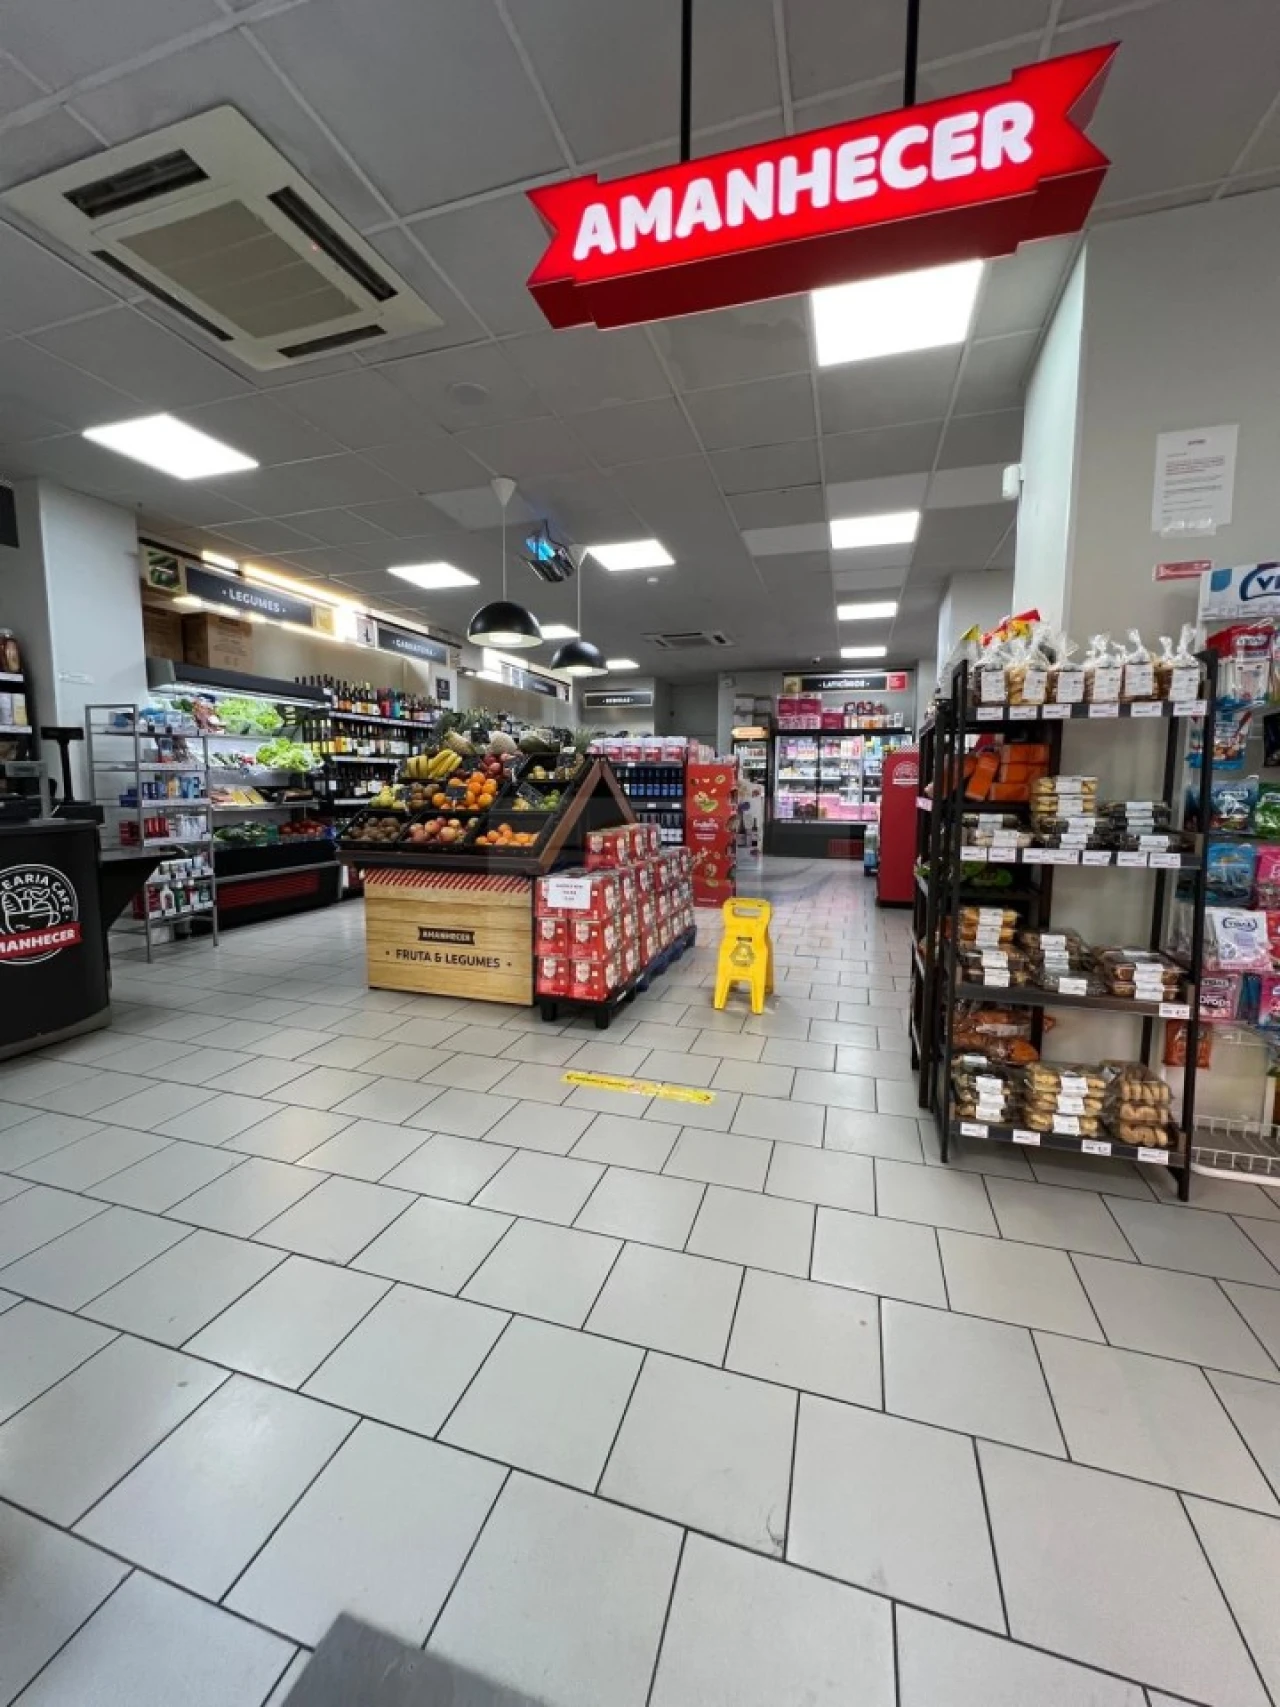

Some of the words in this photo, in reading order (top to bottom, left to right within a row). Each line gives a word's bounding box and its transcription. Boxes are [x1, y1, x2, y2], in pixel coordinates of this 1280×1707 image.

[573, 101, 1036, 262] AMANHECER
[228, 588, 280, 613] LEGUMES
[422, 930, 471, 942] AMANHECER
[395, 948, 431, 963] FRUTA
[434, 951, 443, 963] &
[445, 953, 501, 968] LEGUMES
